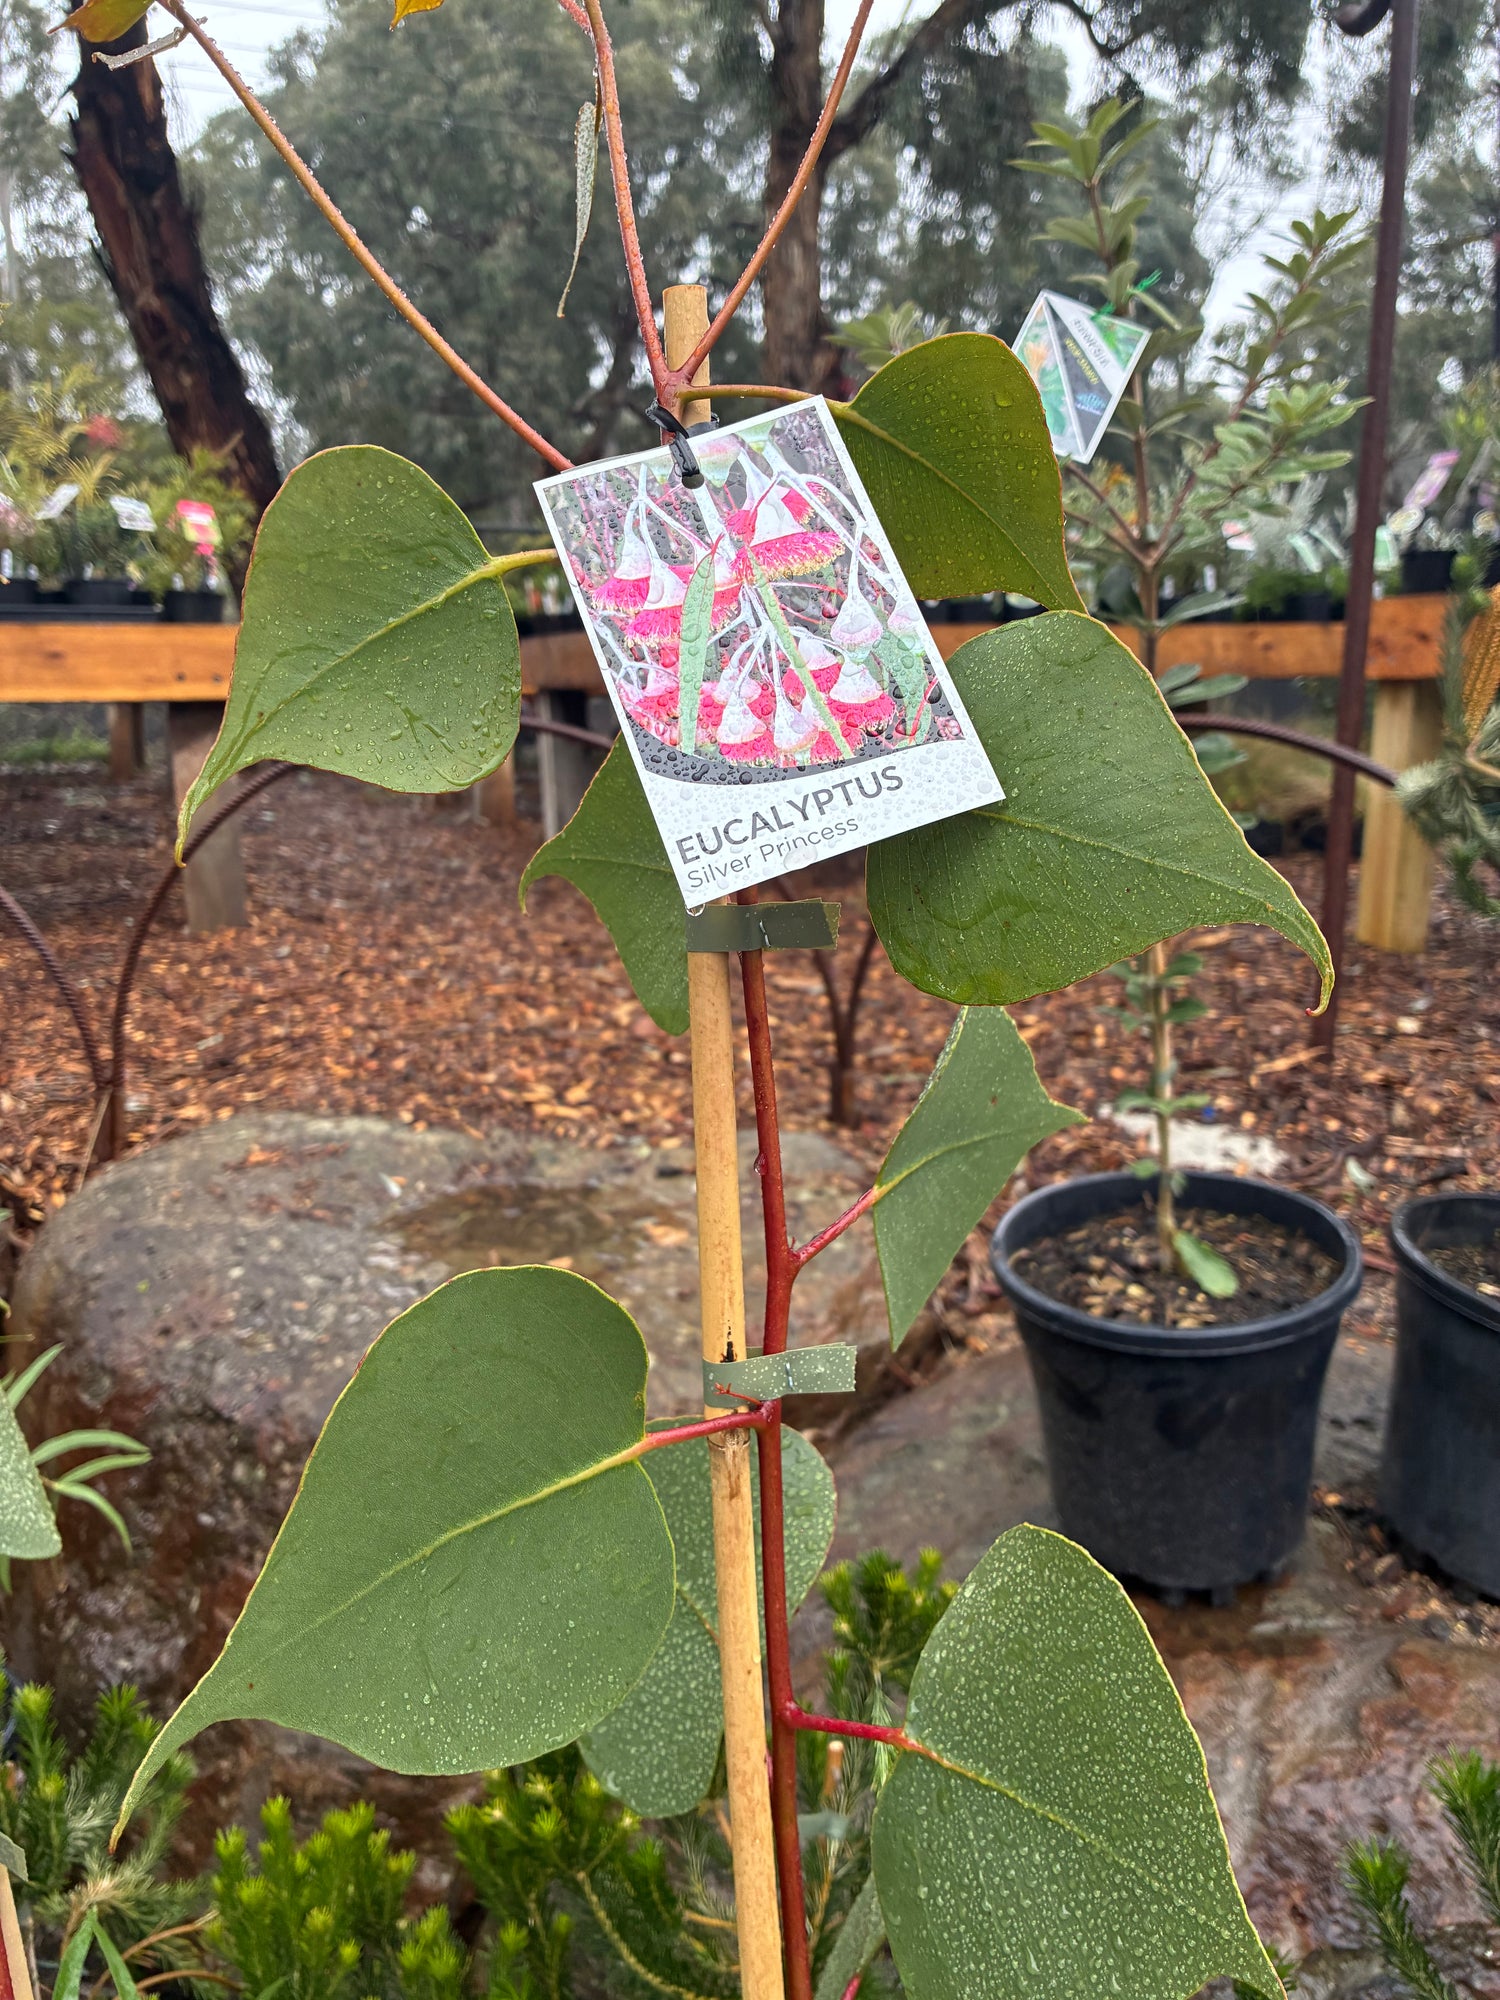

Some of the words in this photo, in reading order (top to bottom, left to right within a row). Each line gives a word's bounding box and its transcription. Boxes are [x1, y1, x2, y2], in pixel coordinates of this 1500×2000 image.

[675, 765, 904, 865] EUCALYPTUS
[687, 853, 752, 888] Silver
[760, 817, 860, 863] Princess
